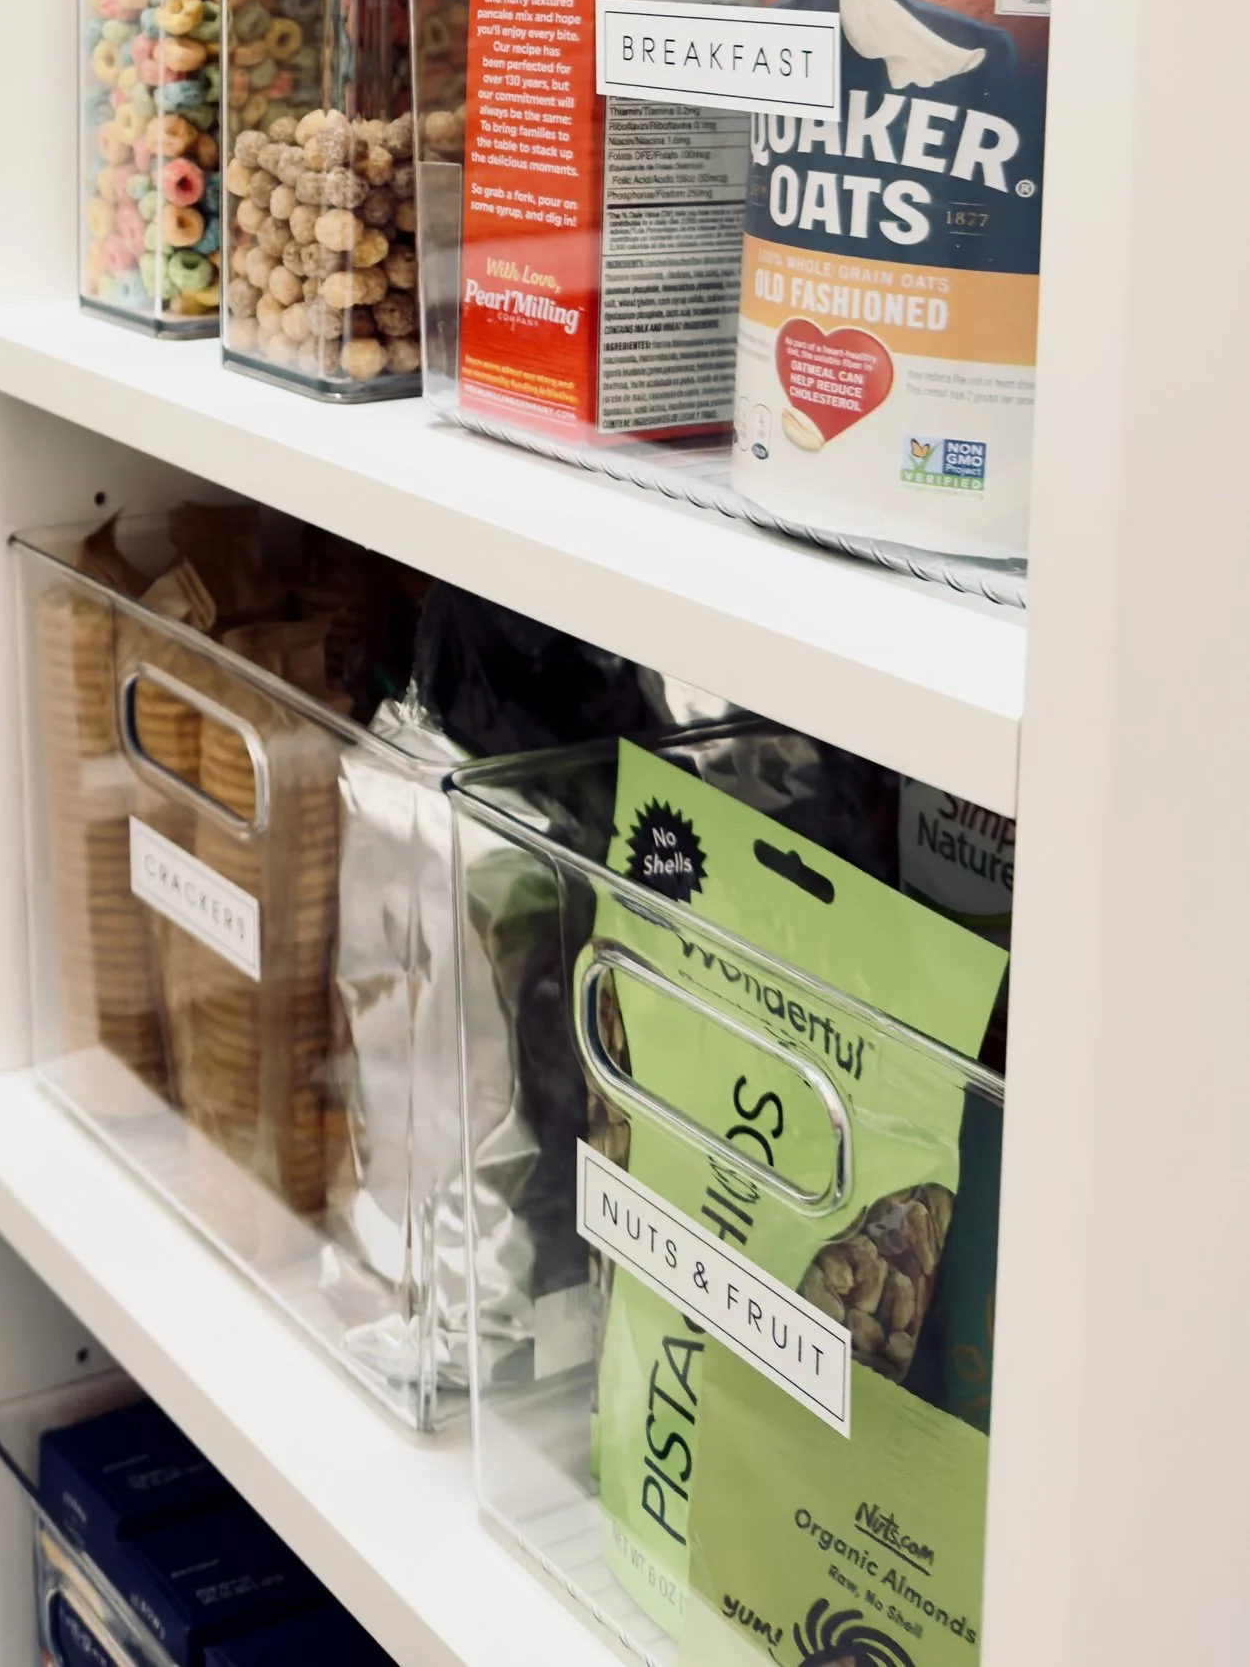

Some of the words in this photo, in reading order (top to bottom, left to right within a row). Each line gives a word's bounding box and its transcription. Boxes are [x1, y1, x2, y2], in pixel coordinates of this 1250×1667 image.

[477, 9, 513, 20] pancake
[515, 11, 533, 22] mix
[535, 12, 553, 22] and
[555, 13, 582, 24] hope
[477, 25, 500, 37] you'll
[502, 26, 526, 40] enjoy
[528, 30, 555, 42] every
[557, 29, 580, 41] bite.
[493, 41, 510, 52] Our
[512, 43, 542, 56] recipe
[543, 45, 560, 57] has
[623, 36, 813, 78] BREAKFAST
[482, 56, 505, 68] been
[507, 60, 554, 72] perfected
[556, 63, 572, 74] for
[483, 74, 502, 84] over
[505, 74, 520, 86] 130
[522, 78, 549, 90] years,
[552, 79, 570, 91] but
[478, 90, 494, 99] our
[495, 92, 555, 106] commitment
[558, 96, 574, 109] will
[479, 105, 508, 119] always
[510, 108, 523, 119] be
[524, 110, 540, 121] the
[542, 112, 572, 125] same:
[480, 120, 491, 130] To
[493, 122, 517, 137] bring
[519, 125, 556, 140] families
[558, 131, 569, 142] to
[750, 89, 1020, 194] QUAKER
[477, 136, 492, 147] the
[494, 139, 517, 151] table
[519, 142, 530, 154] to
[532, 144, 558, 158] stack
[560, 149, 573, 160] up
[471, 152, 486, 162] the
[488, 154, 528, 169] delicious
[530, 161, 579, 176] moments.
[471, 182, 482, 194] So
[484, 186, 505, 198] grab
[506, 191, 512, 200] a
[514, 190, 536, 204] fork,
[538, 195, 562, 208] pour
[564, 200, 577, 210] on
[770, 165, 931, 245] OATS
[470, 201, 495, 214] some
[496, 206, 523, 220] syrup,
[525, 209, 544, 222] and
[546, 213, 562, 227] dig
[564, 215, 577, 227] in!
[946, 210, 989, 228] 1877
[486, 256, 519, 282] With
[522, 265, 562, 294] Love,
[786, 255, 833, 278] WHOLE
[838, 265, 893, 286] GRAIN
[900, 273, 950, 293] OATS
[464, 278, 510, 312] Pearl
[511, 290, 580, 335] Milling
[754, 268, 784, 304] OLD
[790, 277, 949, 331] FASHIONED
[790, 360, 836, 380] OATMEAL
[838, 371, 863, 385] CAN
[790, 373, 815, 387] HELP
[816, 379, 863, 398] REDUCE
[790, 385, 861, 412] CHOLESTEROL
[946, 454, 983, 467] GMO
[947, 442, 983, 455] NON
[904, 471, 982, 489] VERIFIED
[945, 464, 982, 476] Project
[652, 827, 677, 847] No
[917, 811, 1014, 892] Nature
[643, 855, 693, 875] Shells
[144, 854, 245, 940] CRACKERS
[603, 1192, 677, 1268] NUTS
[693, 1261, 710, 1294] &
[727, 1283, 824, 1375] FRUIT
[855, 1502, 935, 1566] Nuts.com
[794, 1508, 878, 1577] Organic
[882, 1568, 977, 1645] Almonds
[828, 1564, 860, 1598] Raw,
[865, 1589, 884, 1611] No
[887, 1606, 924, 1639] Shell
